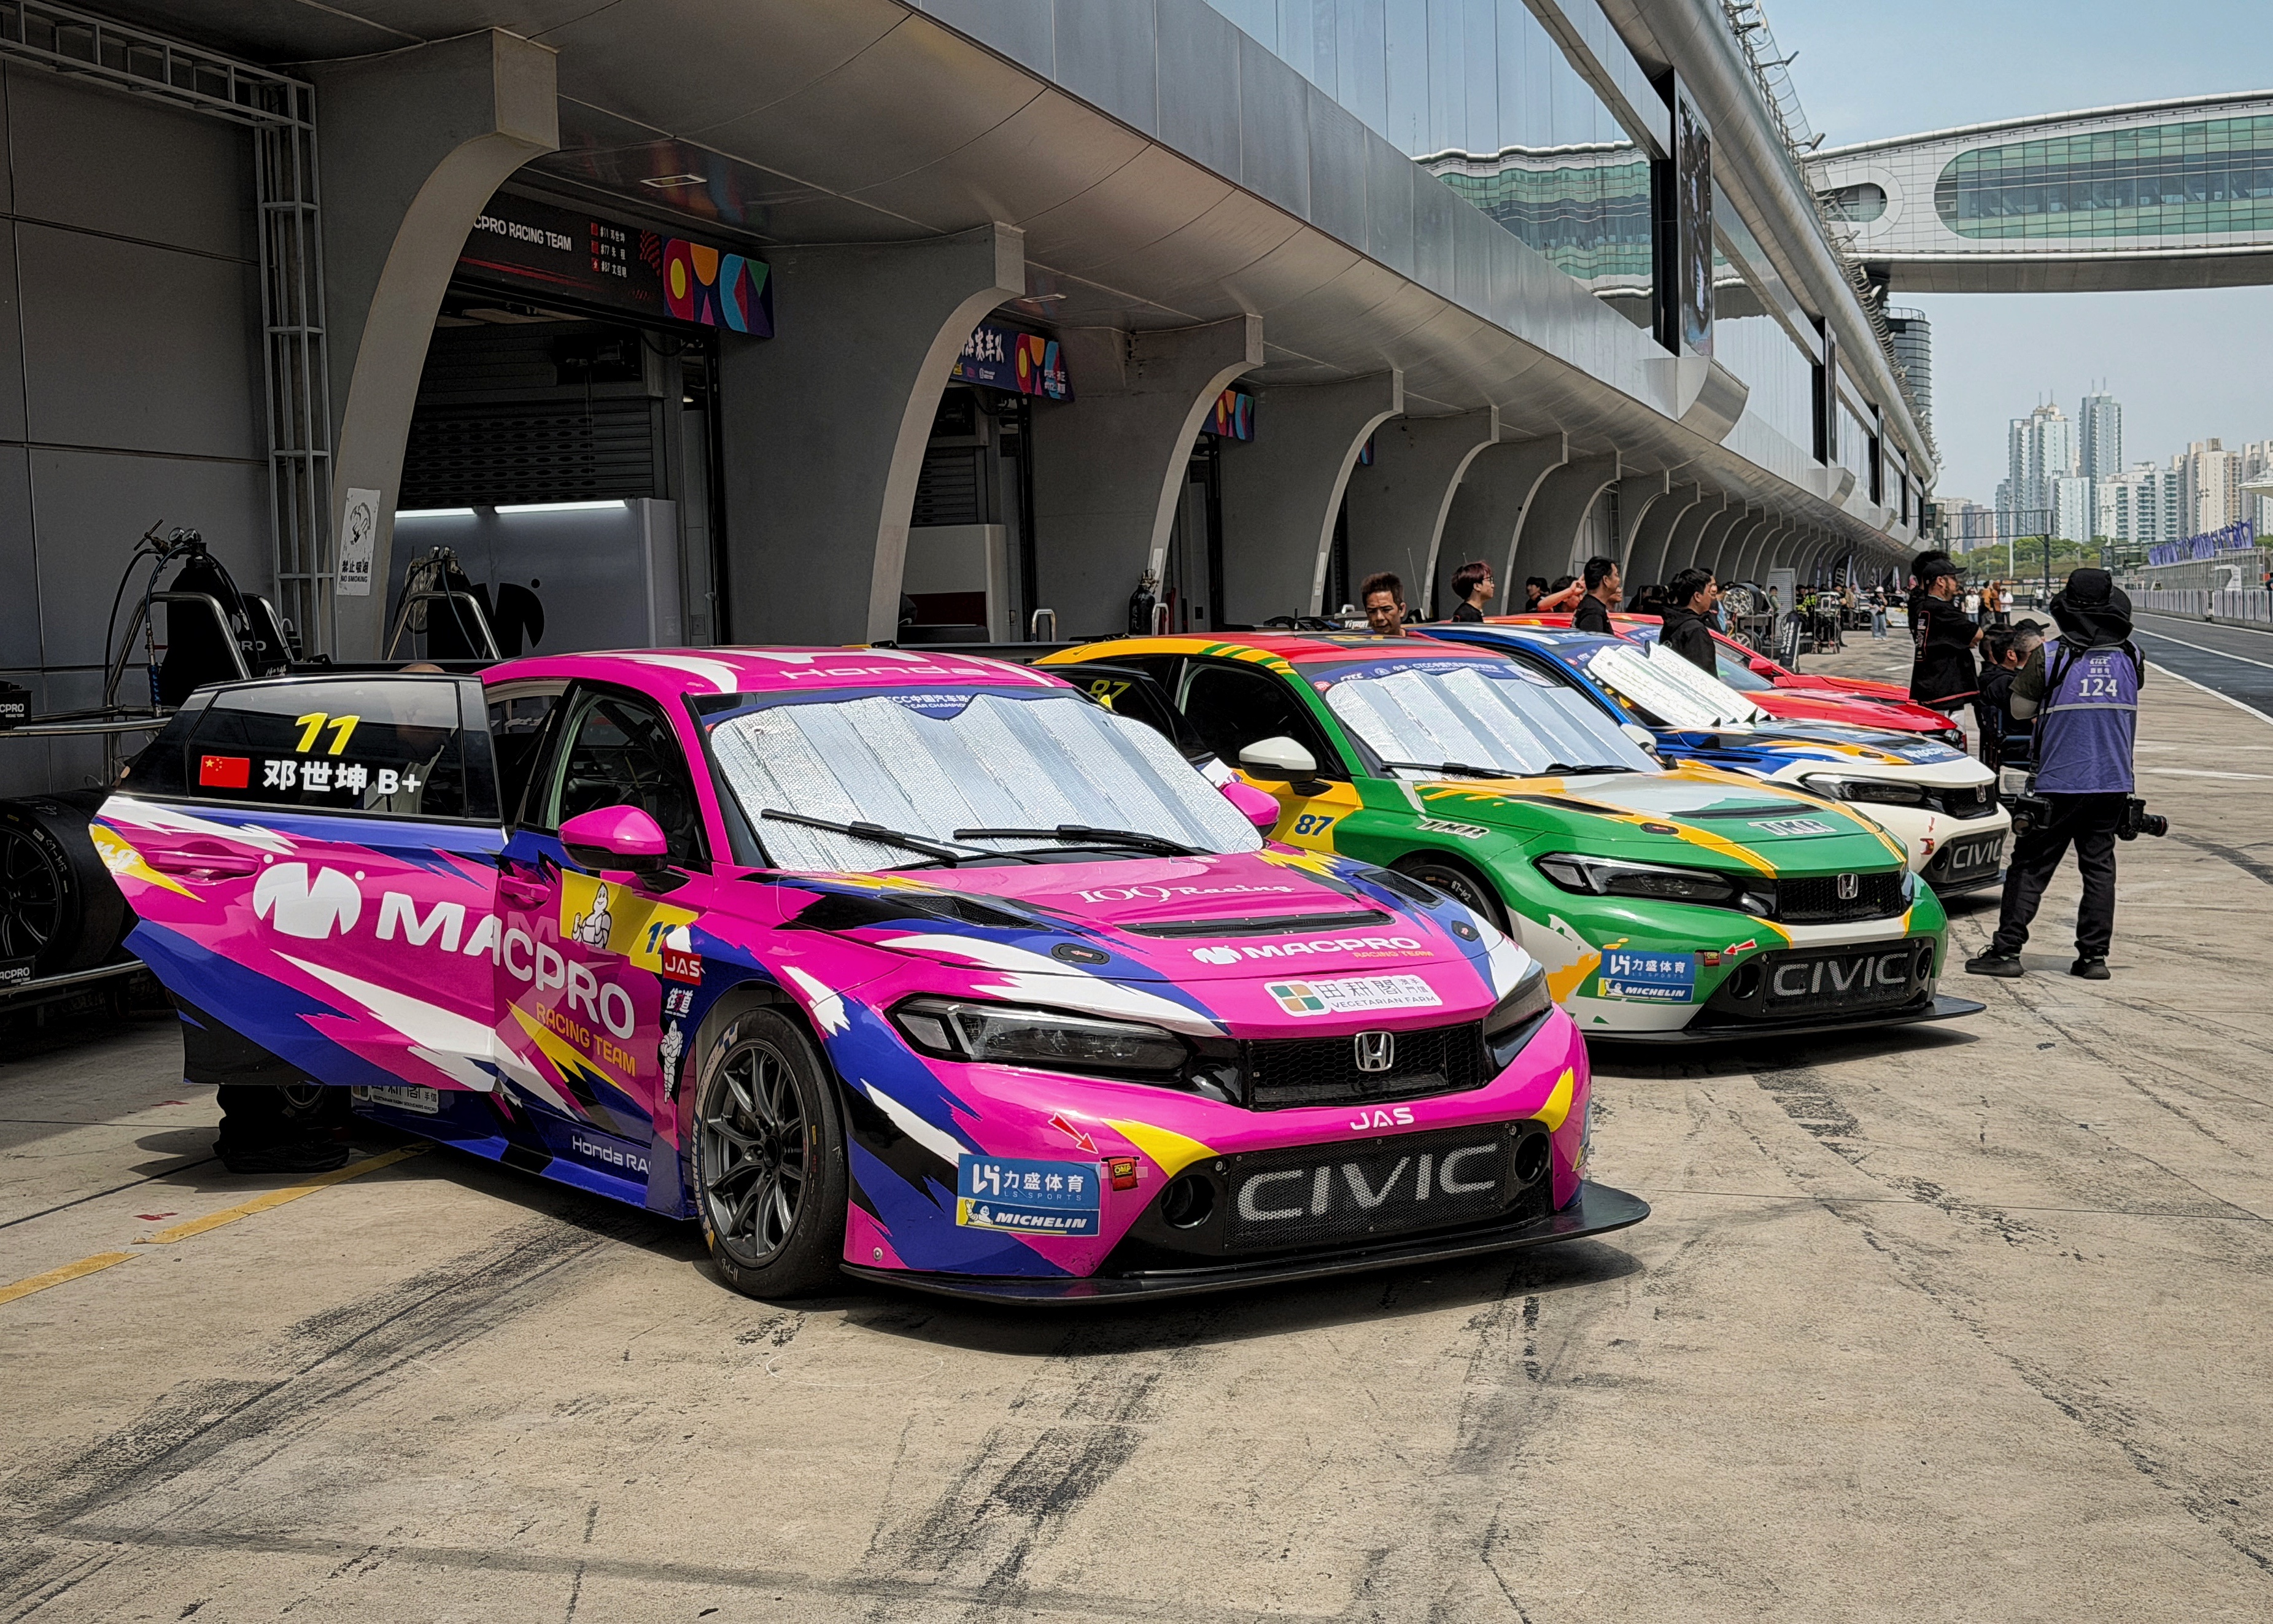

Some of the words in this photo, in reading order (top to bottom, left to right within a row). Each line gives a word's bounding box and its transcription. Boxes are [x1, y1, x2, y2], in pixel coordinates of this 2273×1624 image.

[509, 222, 544, 244] RACING
[546, 231, 572, 252] TEAM
[341, 560, 369, 574] 禁止吸烟
[780, 665, 990, 681] Honda
[2079, 678, 2118, 697] 124
[295, 711, 360, 756] 11
[263, 759, 368, 795] 邓世坤
[378, 768, 422, 795] B+
[1295, 814, 1334, 837] 87
[1953, 838, 2001, 868] CIVIC
[1169, 884, 1295, 897] Racing
[1240, 937, 1422, 960] MACPRO
[665, 956, 700, 978] JAS
[1632, 959, 1686, 974] 力盛体育
[1774, 953, 1908, 996] CIVIC
[1331, 997, 1403, 1008] VEGETARIAN
[1625, 986, 1686, 997] MICHELIN
[536, 1002, 591, 1045] RACING
[594, 1033, 637, 1077] TEAM
[1350, 1107, 1414, 1131] JAS
[572, 1135, 624, 1167] Honda
[626, 1153, 651, 1175] RA
[1113, 1164, 1132, 1175] OMP
[1003, 1169, 1085, 1194] 力盛体育
[1237, 1142, 1498, 1222] CIVIC
[1028, 1191, 1083, 1201] SPORTS
[995, 1212, 1087, 1228] MICHELIN
